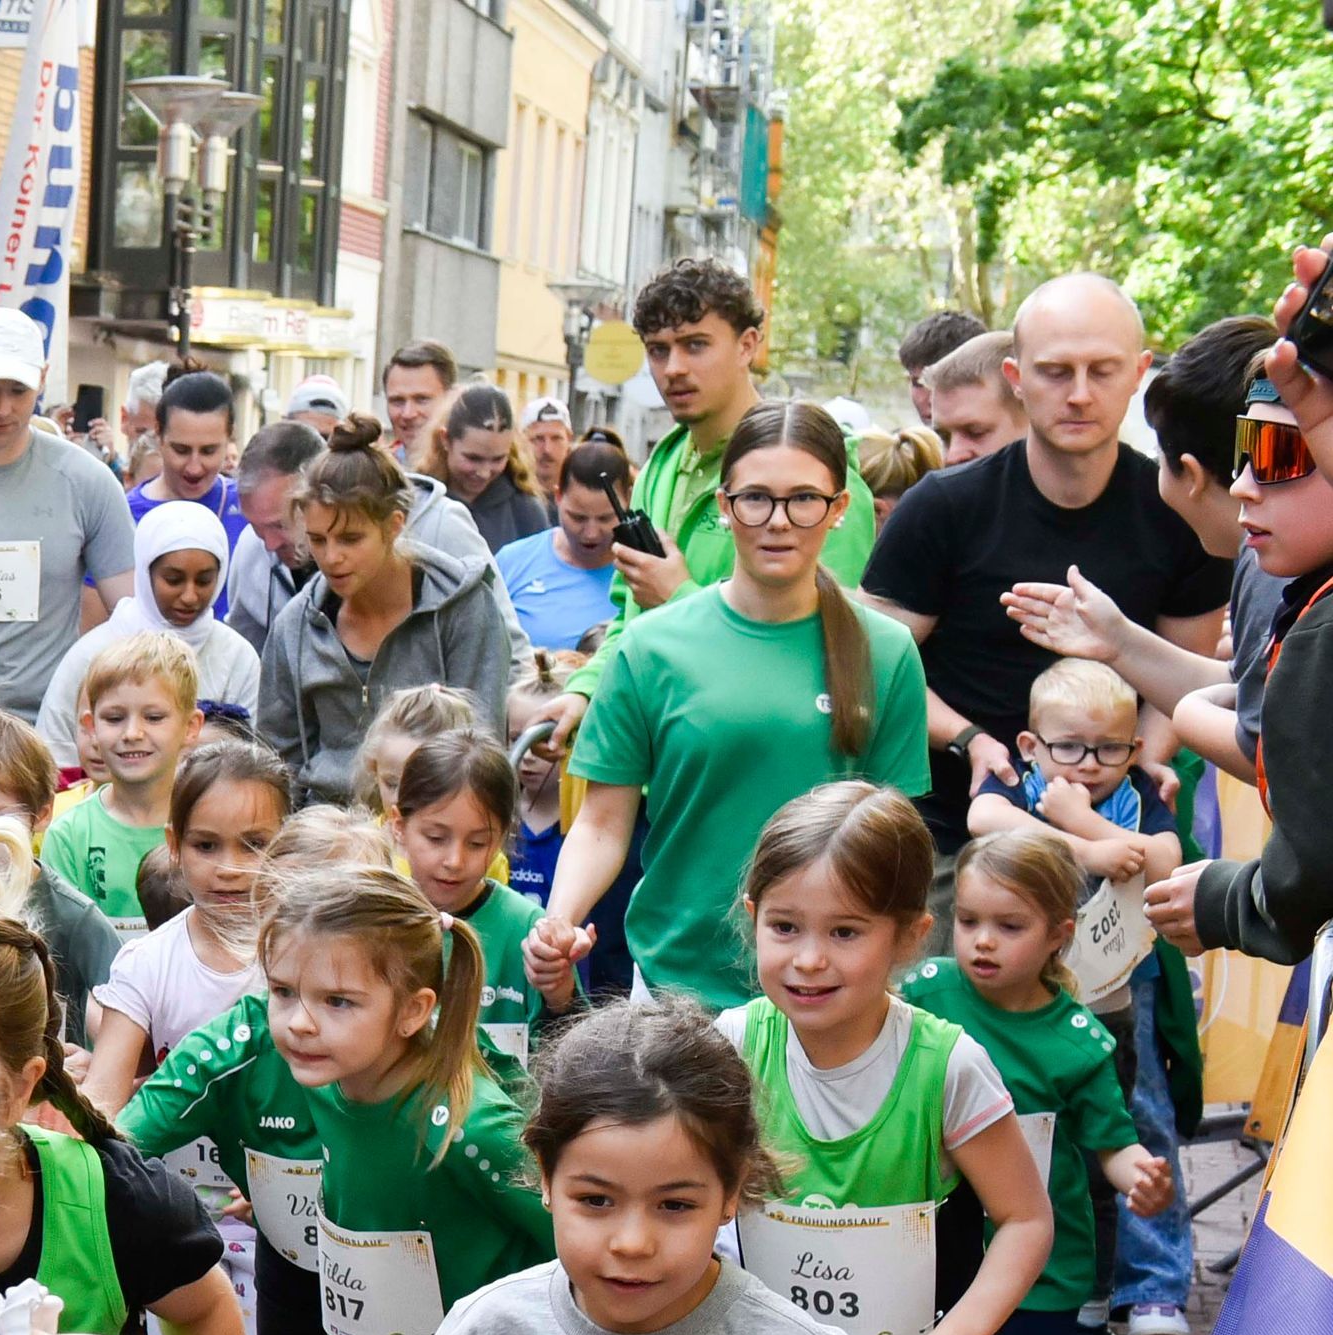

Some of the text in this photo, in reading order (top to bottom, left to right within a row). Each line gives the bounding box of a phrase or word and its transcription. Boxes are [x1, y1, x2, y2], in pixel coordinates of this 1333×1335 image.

[1090, 900, 1121, 944] 2302
[258, 1116, 296, 1130] JAKO
[196, 1144, 220, 1163] 16
[790, 1251, 855, 1281] Lisa
[325, 1286, 365, 1321] 817
[790, 1285, 860, 1318] 803
